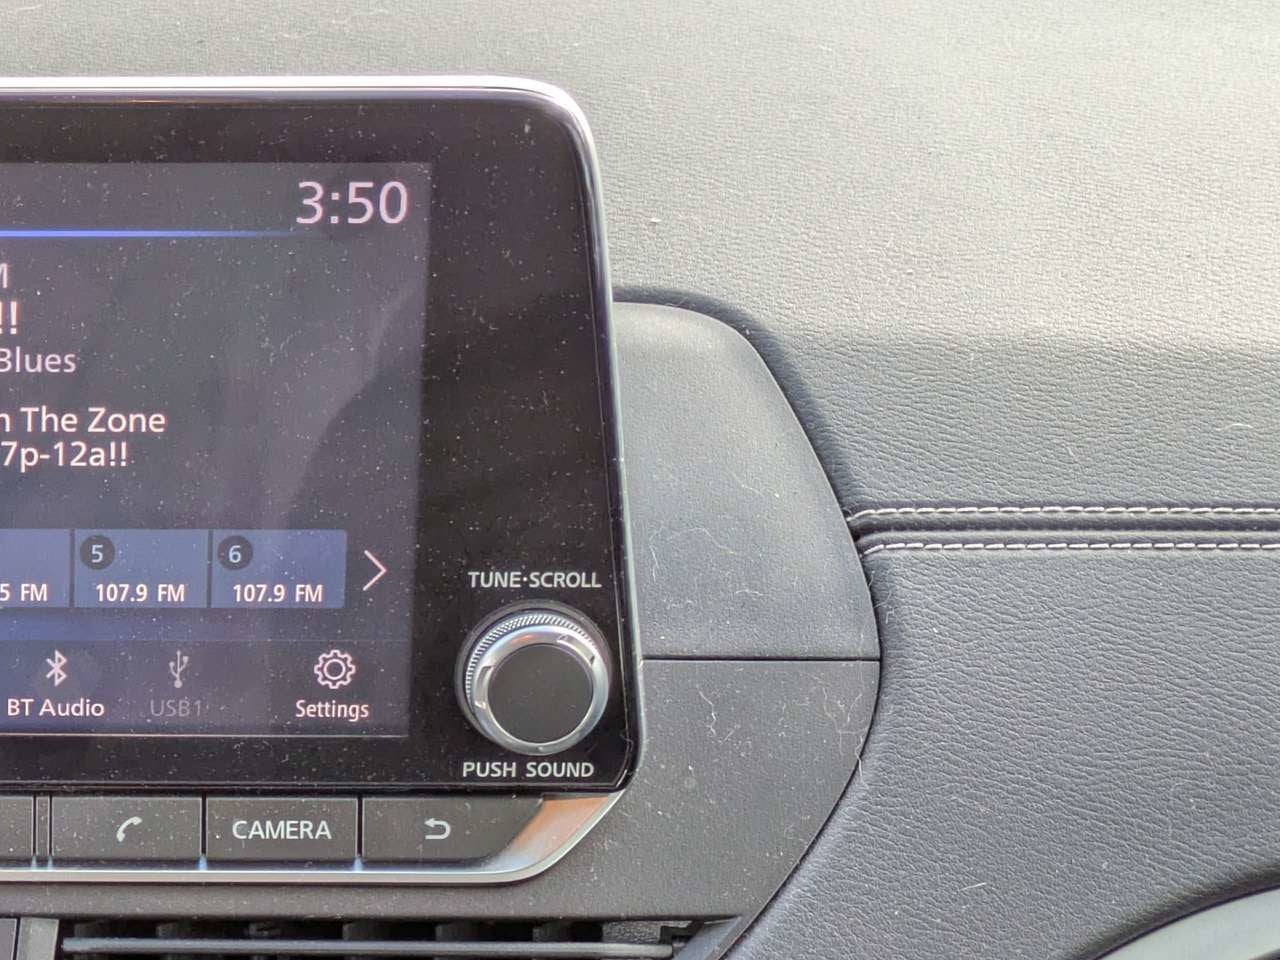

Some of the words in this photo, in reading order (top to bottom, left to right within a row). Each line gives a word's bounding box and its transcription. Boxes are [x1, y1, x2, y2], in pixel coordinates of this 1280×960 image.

[295, 180, 409, 225] 3:50
[19, 404, 78, 433] The
[87, 406, 166, 433] Zone
[0, 440, 127, 473] 7p-12a!!
[91, 544, 104, 563] 5
[228, 544, 242, 564] 6
[20, 583, 48, 602] FM
[95, 583, 148, 602] 107.9
[157, 583, 185, 602] FM
[232, 583, 286, 603] 107.9
[295, 583, 323, 603] FM
[7, 698, 35, 716] BT
[38, 697, 105, 717] Audio
[150, 699, 201, 717] USB1
[295, 699, 369, 723] Settings
[462, 761, 517, 778] PUSH
[525, 761, 595, 778] SOUND
[232, 820, 332, 840] CAMERA
